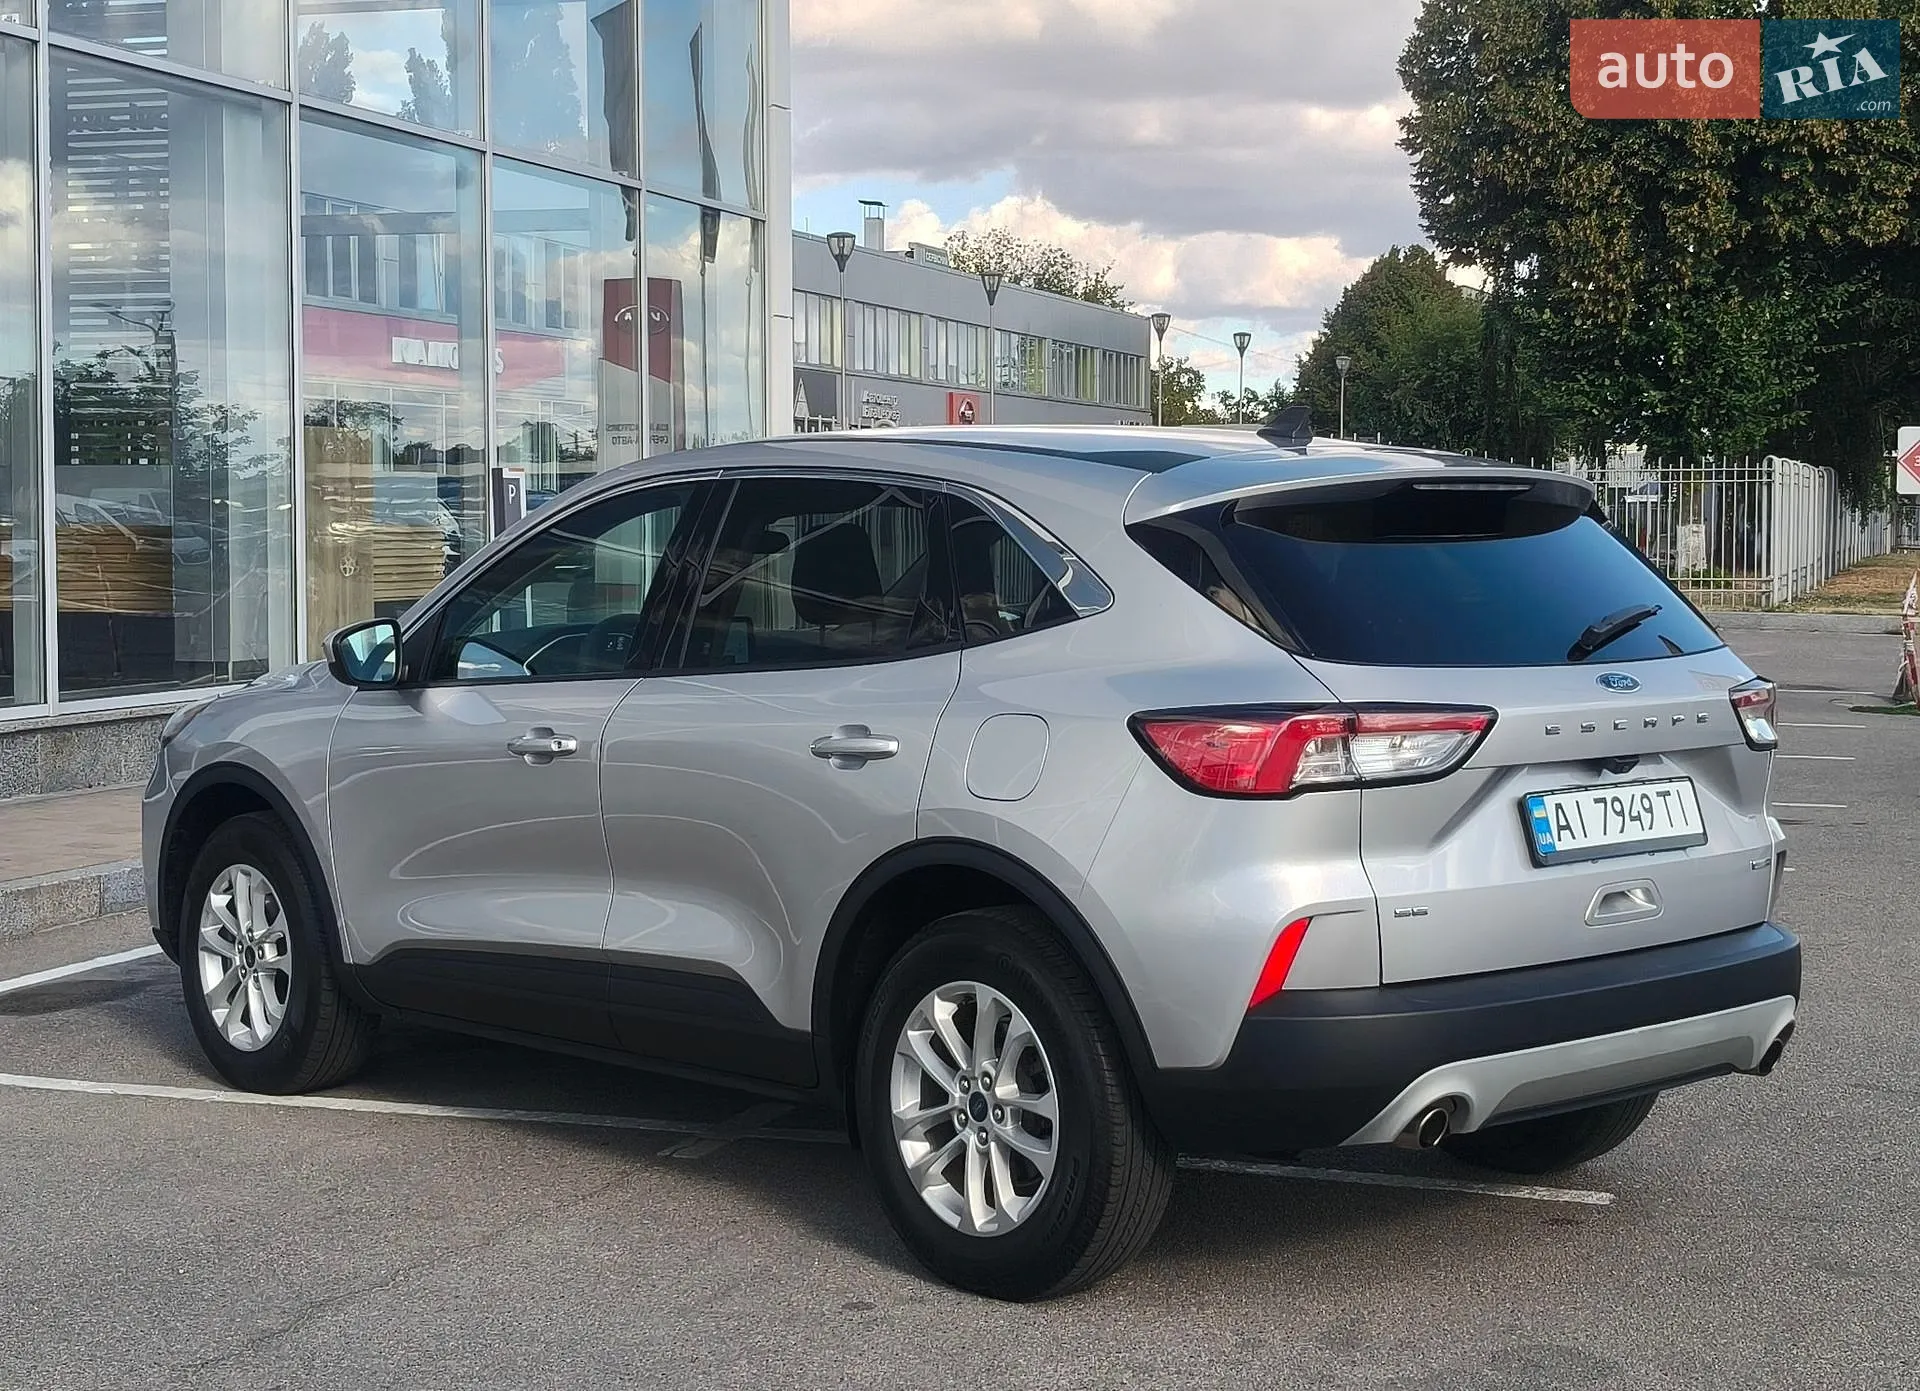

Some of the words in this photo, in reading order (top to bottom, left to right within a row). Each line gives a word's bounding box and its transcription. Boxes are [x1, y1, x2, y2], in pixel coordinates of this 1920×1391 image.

[508, 484, 516, 505] P
[1607, 675, 1634, 689] Ford
[1544, 712, 1710, 736] ESCAPE
[1539, 832, 1554, 846] UA
[1393, 906, 1429, 919] SE
